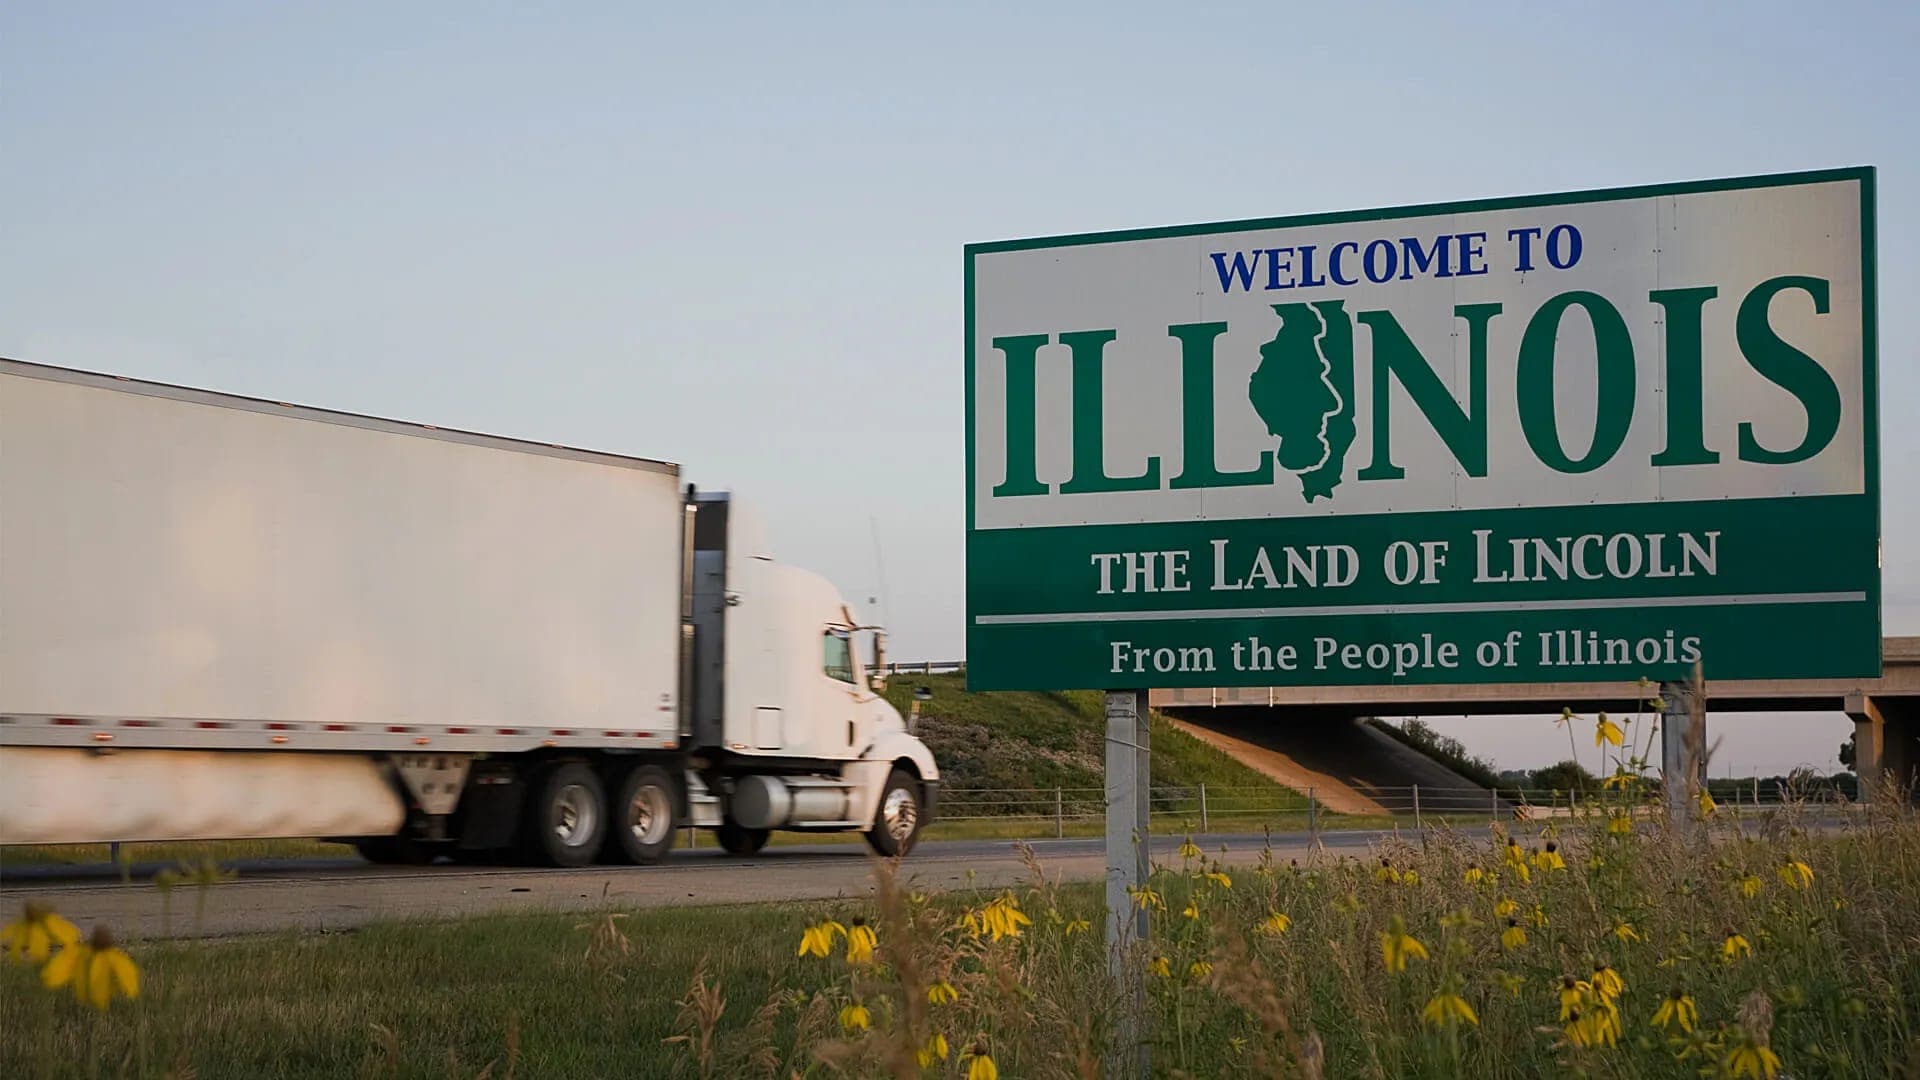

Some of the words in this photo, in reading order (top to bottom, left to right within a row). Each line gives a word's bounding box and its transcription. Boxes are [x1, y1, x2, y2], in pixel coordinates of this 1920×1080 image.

[1210, 232, 1488, 293] WELCOME
[1508, 224, 1583, 272] TO
[1091, 550, 1191, 595] THE
[1211, 539, 1360, 591] LAND
[1383, 541, 1449, 586] OF
[1472, 529, 1721, 583] LINCOLN
[1110, 641, 1217, 673] From
[1230, 637, 1298, 671] the
[1314, 633, 1459, 676] People
[1476, 631, 1522, 668] of
[1538, 629, 1702, 666] Illinois
